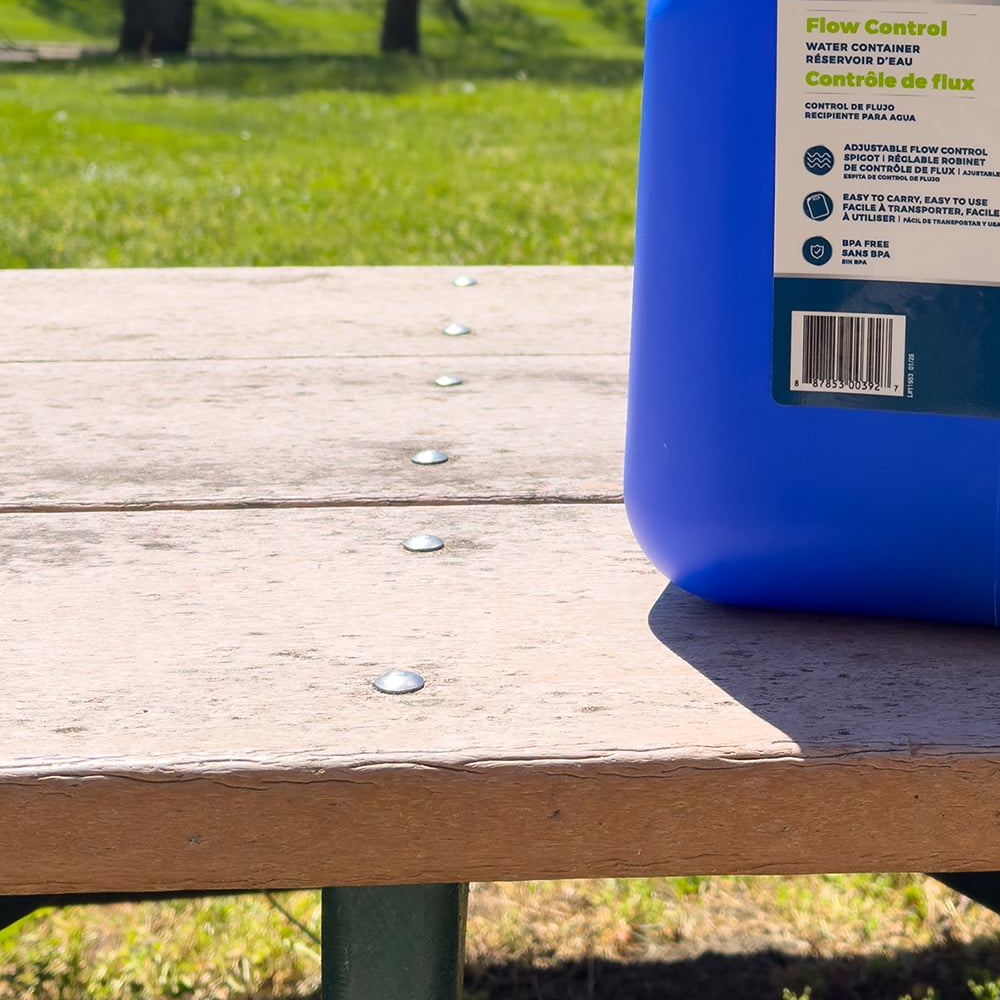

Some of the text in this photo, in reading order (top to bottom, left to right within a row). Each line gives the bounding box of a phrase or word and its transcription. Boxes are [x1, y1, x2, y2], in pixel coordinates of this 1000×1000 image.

[806, 17, 947, 36] Flow Control
[806, 42, 920, 53] WATER CONTAINER
[806, 53, 873, 65] RÉSERVOIR
[805, 70, 975, 91] Contrôle de flux
[805, 112, 859, 120] RECIPIENTE
[844, 144, 988, 156] ADJUSTABLE FLOW CONTROL
[844, 153, 986, 166] SPIGOT RÉGLABLE ROBINET
[860, 163, 912, 174] CONTRÔLE
[931, 167, 955, 175] FLUX
[887, 195, 922, 204] CARRY,
[924, 196, 950, 204] EASY
[843, 203, 1000, 217] FACILE À TRANSPORTER, FACILE
[842, 212, 850, 221] À
[852, 214, 895, 223] UTILISER
[842, 249, 868, 257] SANS
[812, 379, 844, 389] 87853
[848, 381, 880, 391] 00392
